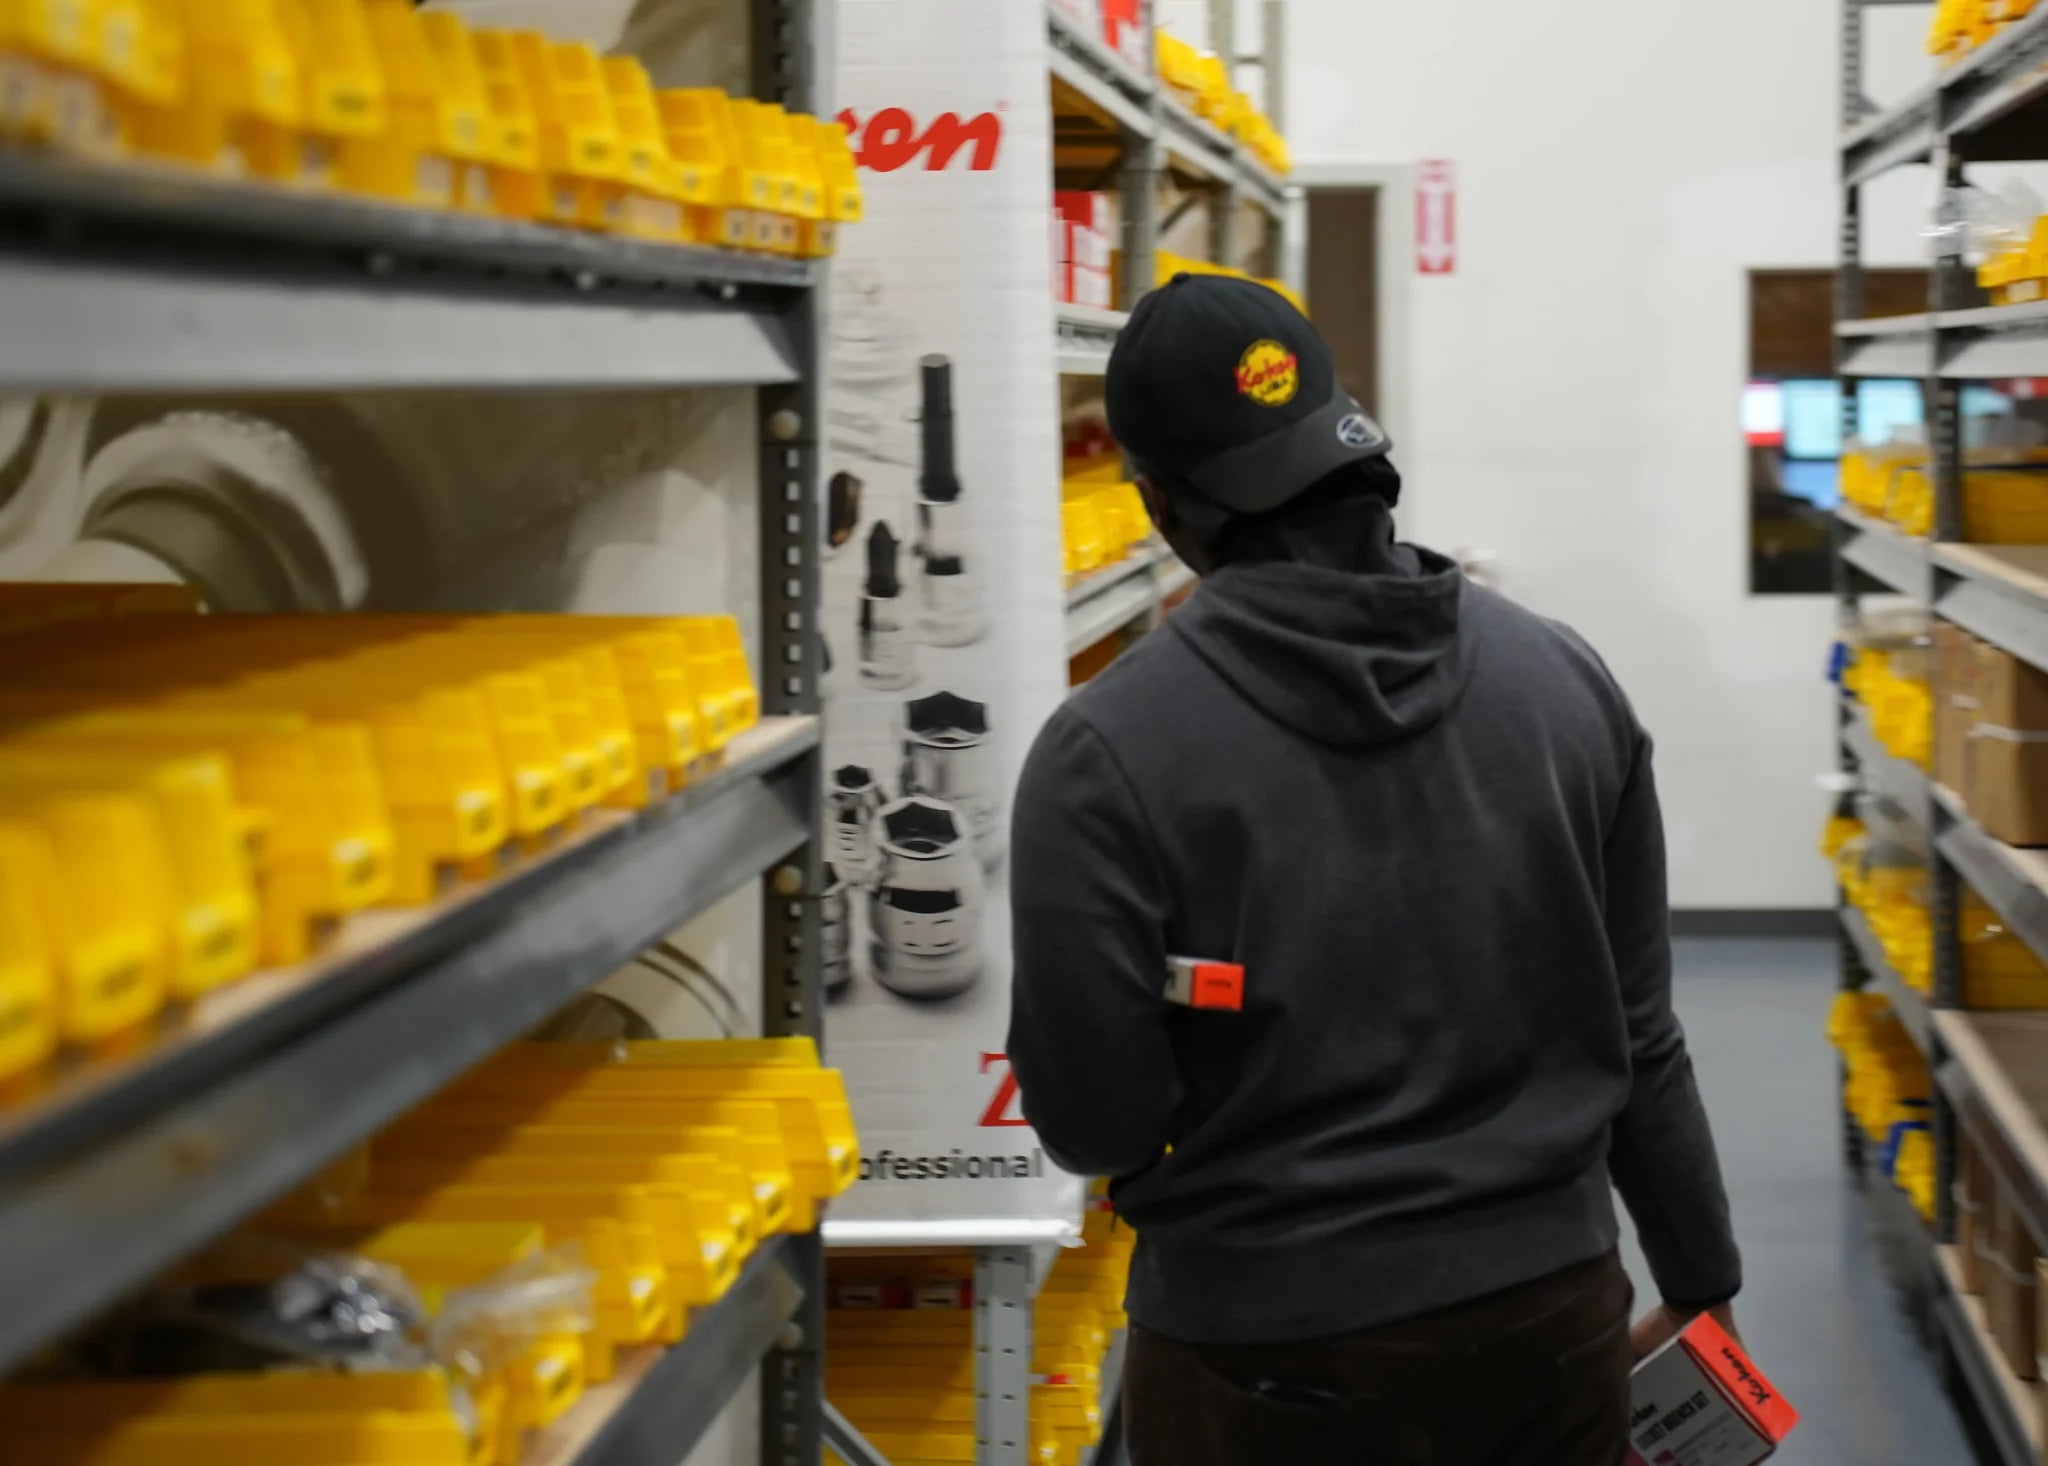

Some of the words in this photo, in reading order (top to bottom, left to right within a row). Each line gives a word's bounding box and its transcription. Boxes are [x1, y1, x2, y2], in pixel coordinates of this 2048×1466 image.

[977, 1051, 1032, 1127] Z
[858, 1148, 1043, 1181] ofessional
[1721, 1347, 1771, 1405] Koken
